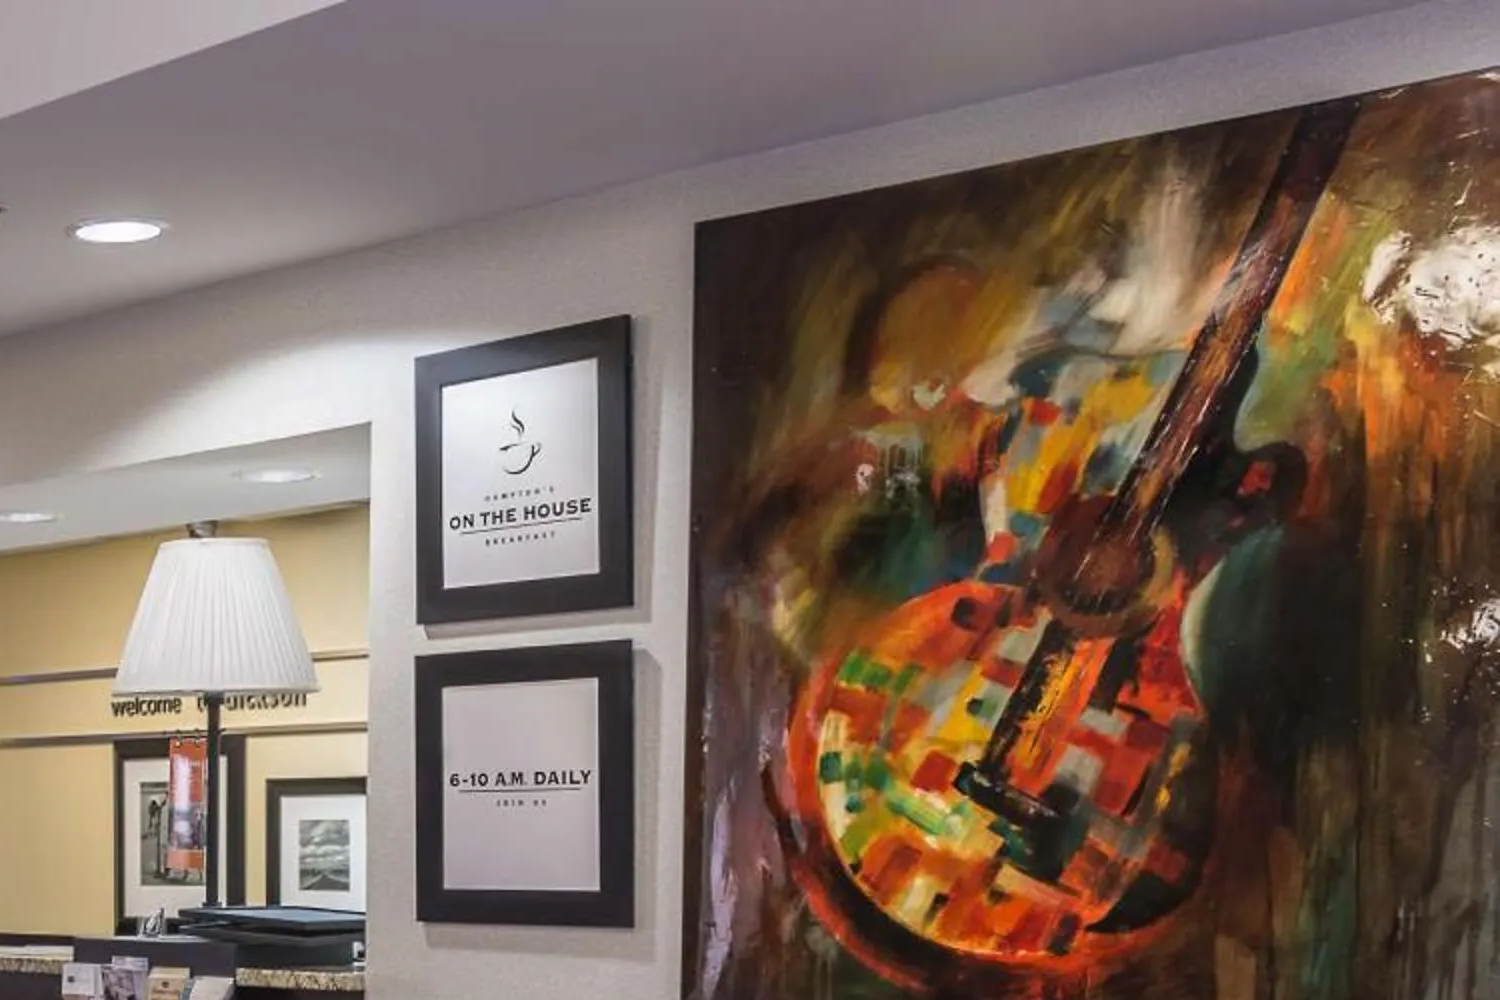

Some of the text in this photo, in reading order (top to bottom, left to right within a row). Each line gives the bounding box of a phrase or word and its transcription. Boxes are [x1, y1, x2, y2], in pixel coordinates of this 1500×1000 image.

[449, 497, 592, 531] ON THE HOUSE
[111, 697, 182, 717] welcome
[449, 769, 591, 787] 6-10 A.M. DAILY
